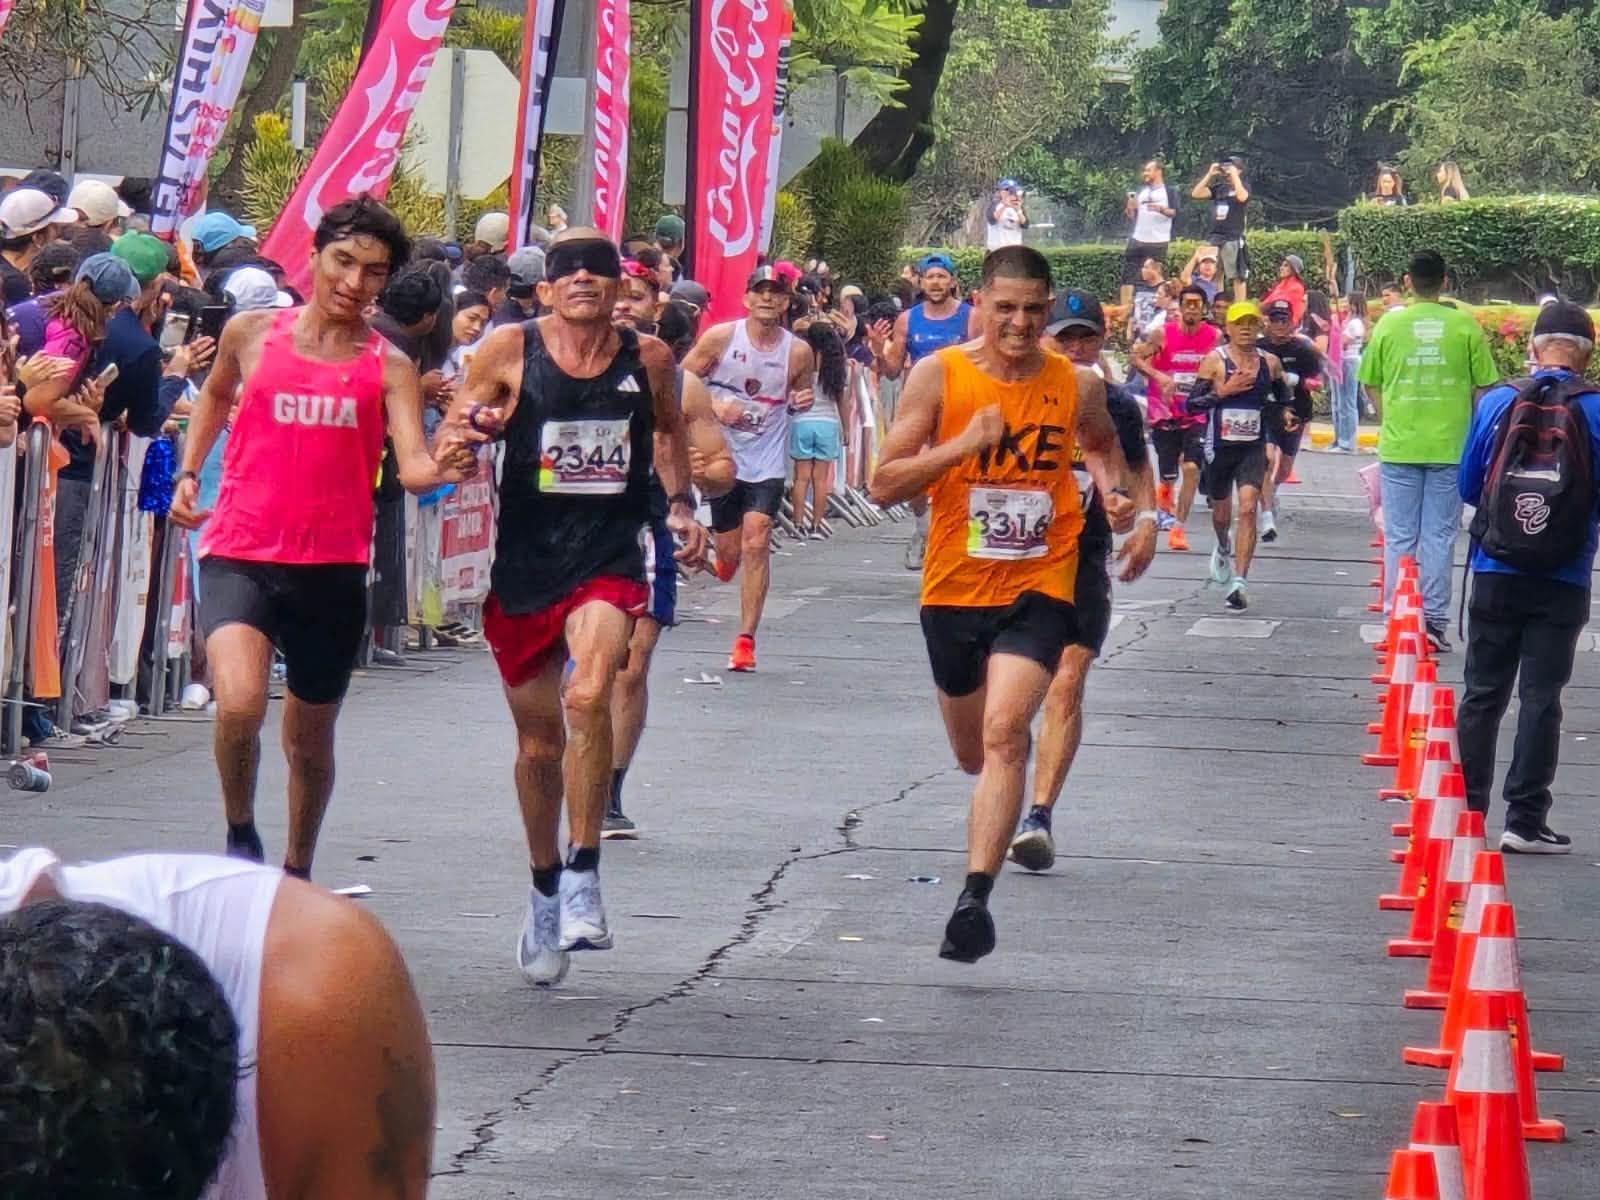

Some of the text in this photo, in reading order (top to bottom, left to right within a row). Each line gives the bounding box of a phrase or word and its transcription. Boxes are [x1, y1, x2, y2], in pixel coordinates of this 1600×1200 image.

[274, 393, 359, 429] GUIA
[546, 445, 626, 470] 2344
[974, 510, 1050, 538] 3316
